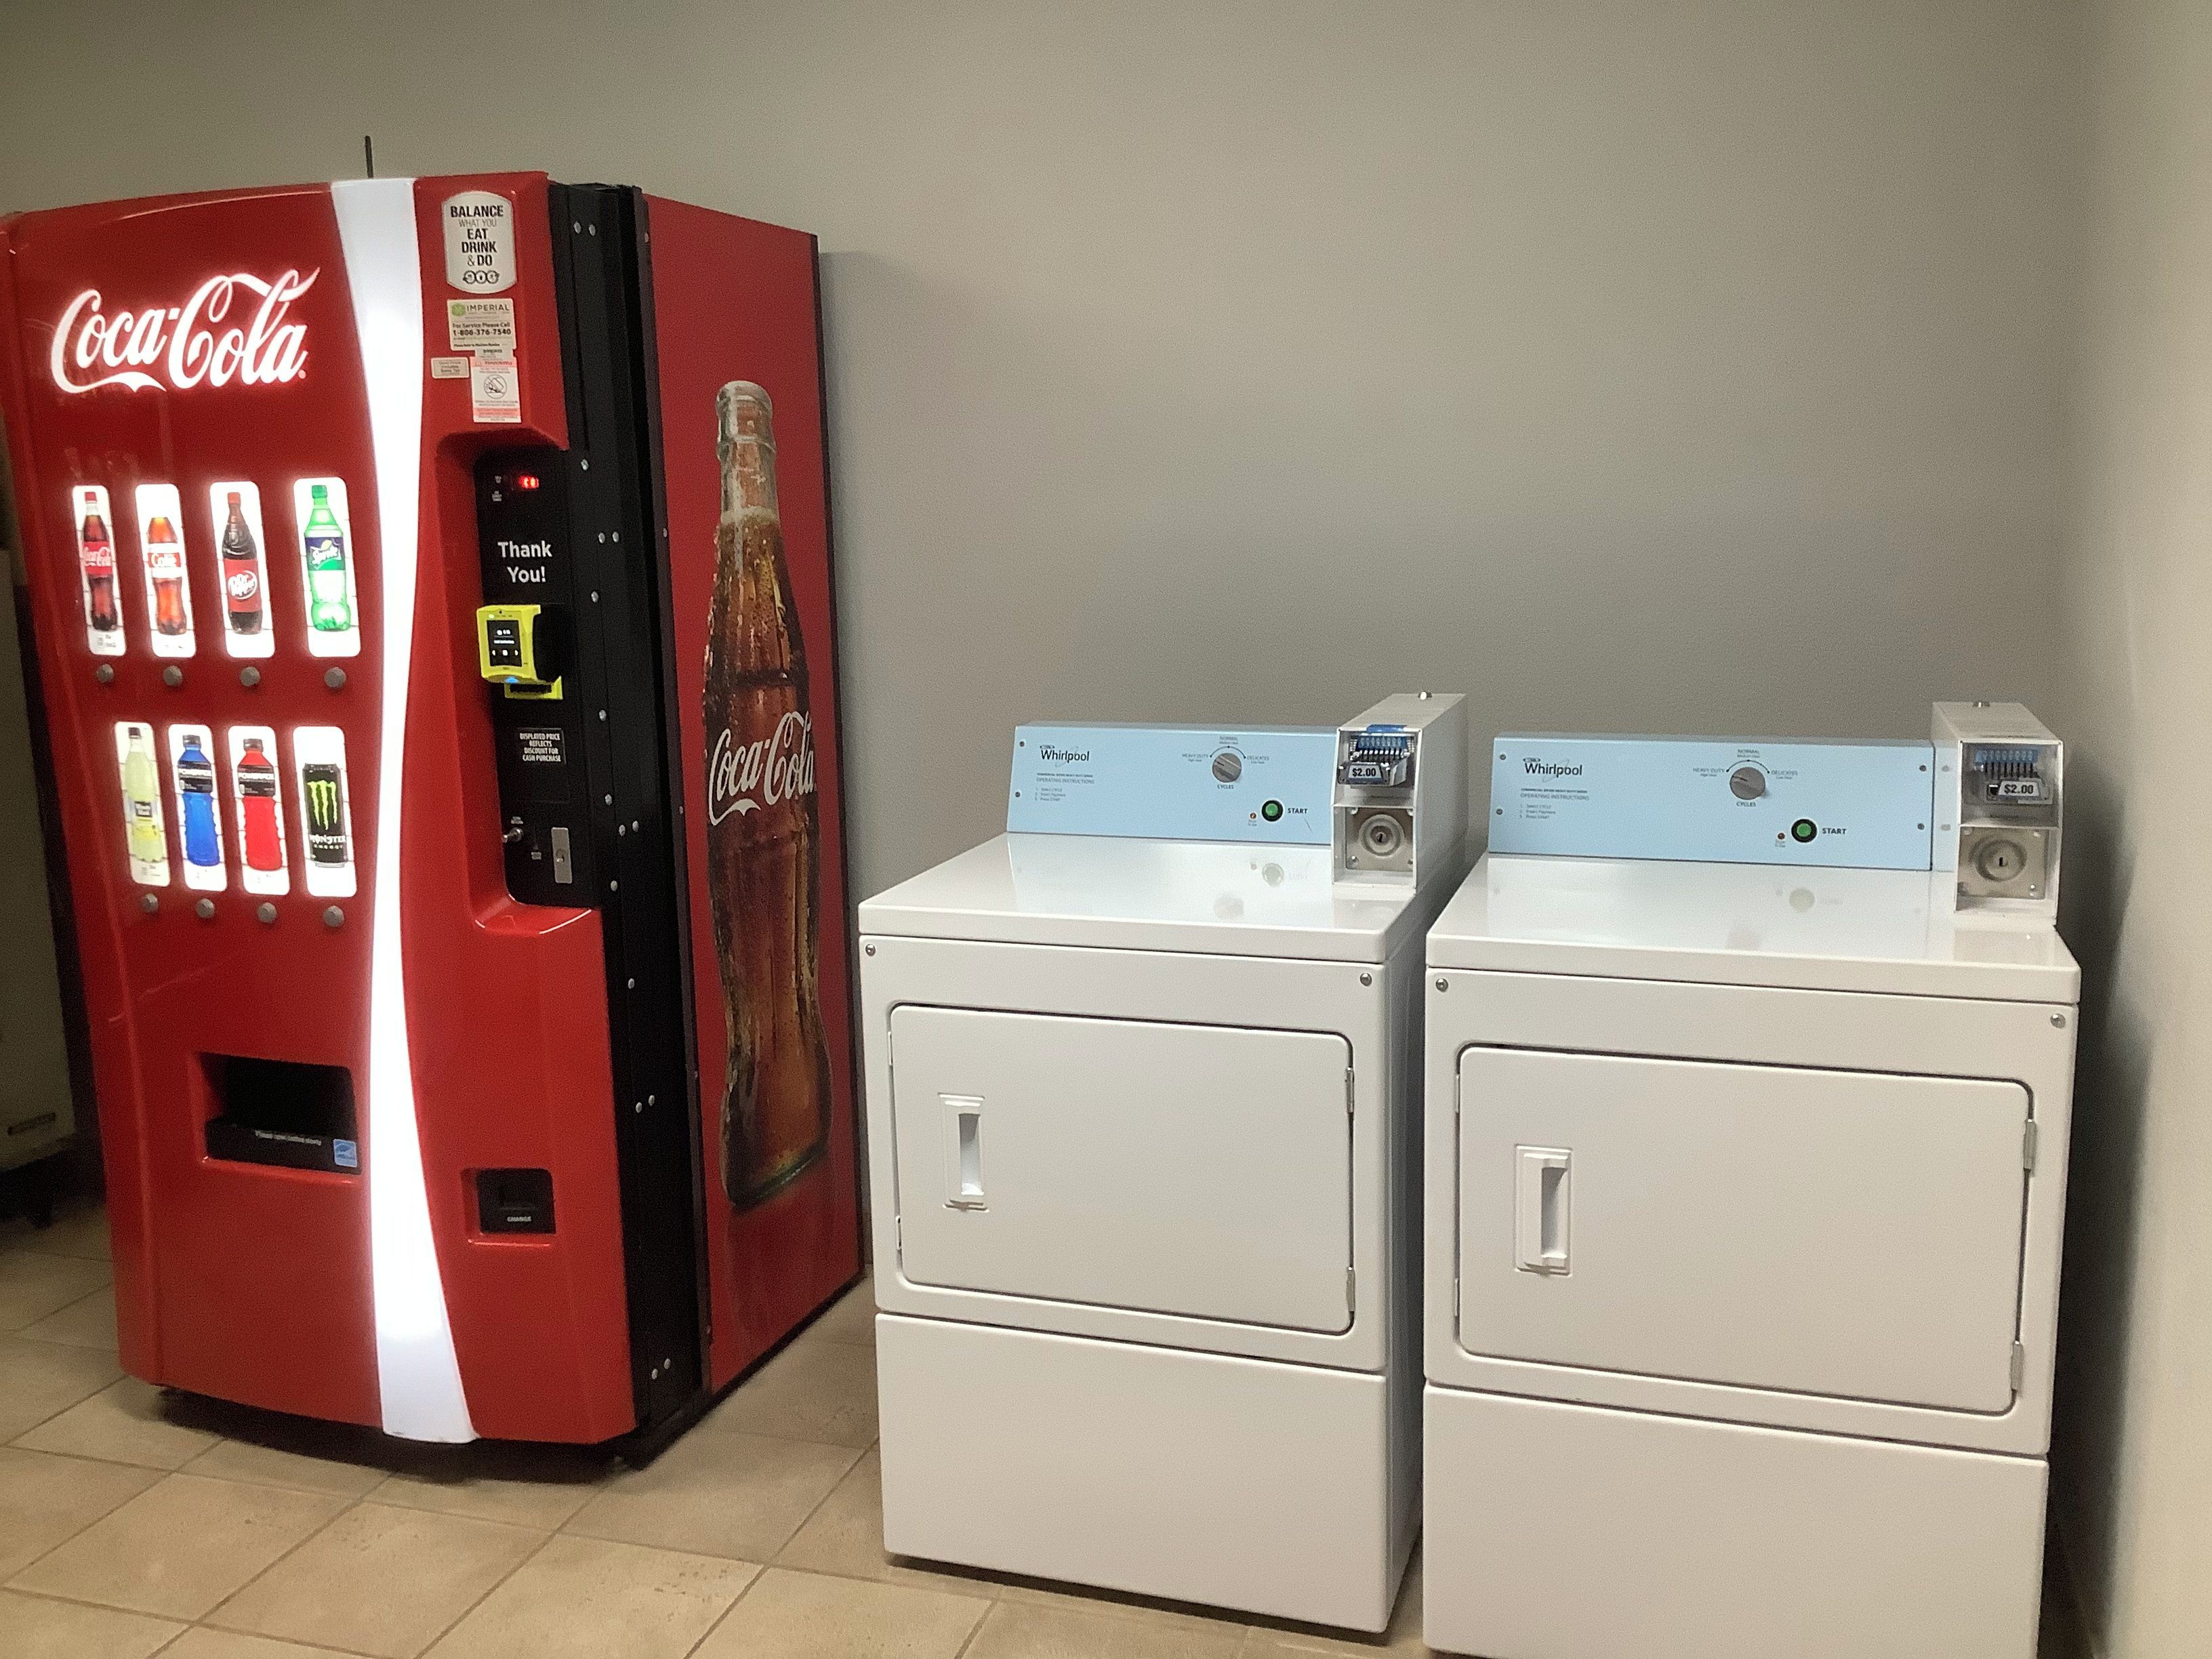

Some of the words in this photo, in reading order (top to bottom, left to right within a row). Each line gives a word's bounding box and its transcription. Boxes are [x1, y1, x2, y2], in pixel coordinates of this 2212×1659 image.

[450, 205, 504, 218] BALANCE
[459, 218, 480, 228] WHAT
[482, 218, 497, 227] YOU
[467, 228, 488, 240] EAT
[462, 241, 497, 253] DRINK
[477, 254, 493, 266] DO
[466, 304, 510, 312] IMPERIAL
[52, 267, 321, 394] Coca-Cola
[497, 540, 552, 558] Thank
[507, 565, 546, 583] You!
[1040, 750, 1090, 763] Whirlpool
[709, 711, 814, 826] Coca-Cola
[1352, 768, 1376, 777] $2.00
[1525, 762, 1582, 778] Whirlpool
[2004, 784, 2034, 794] $2.00
